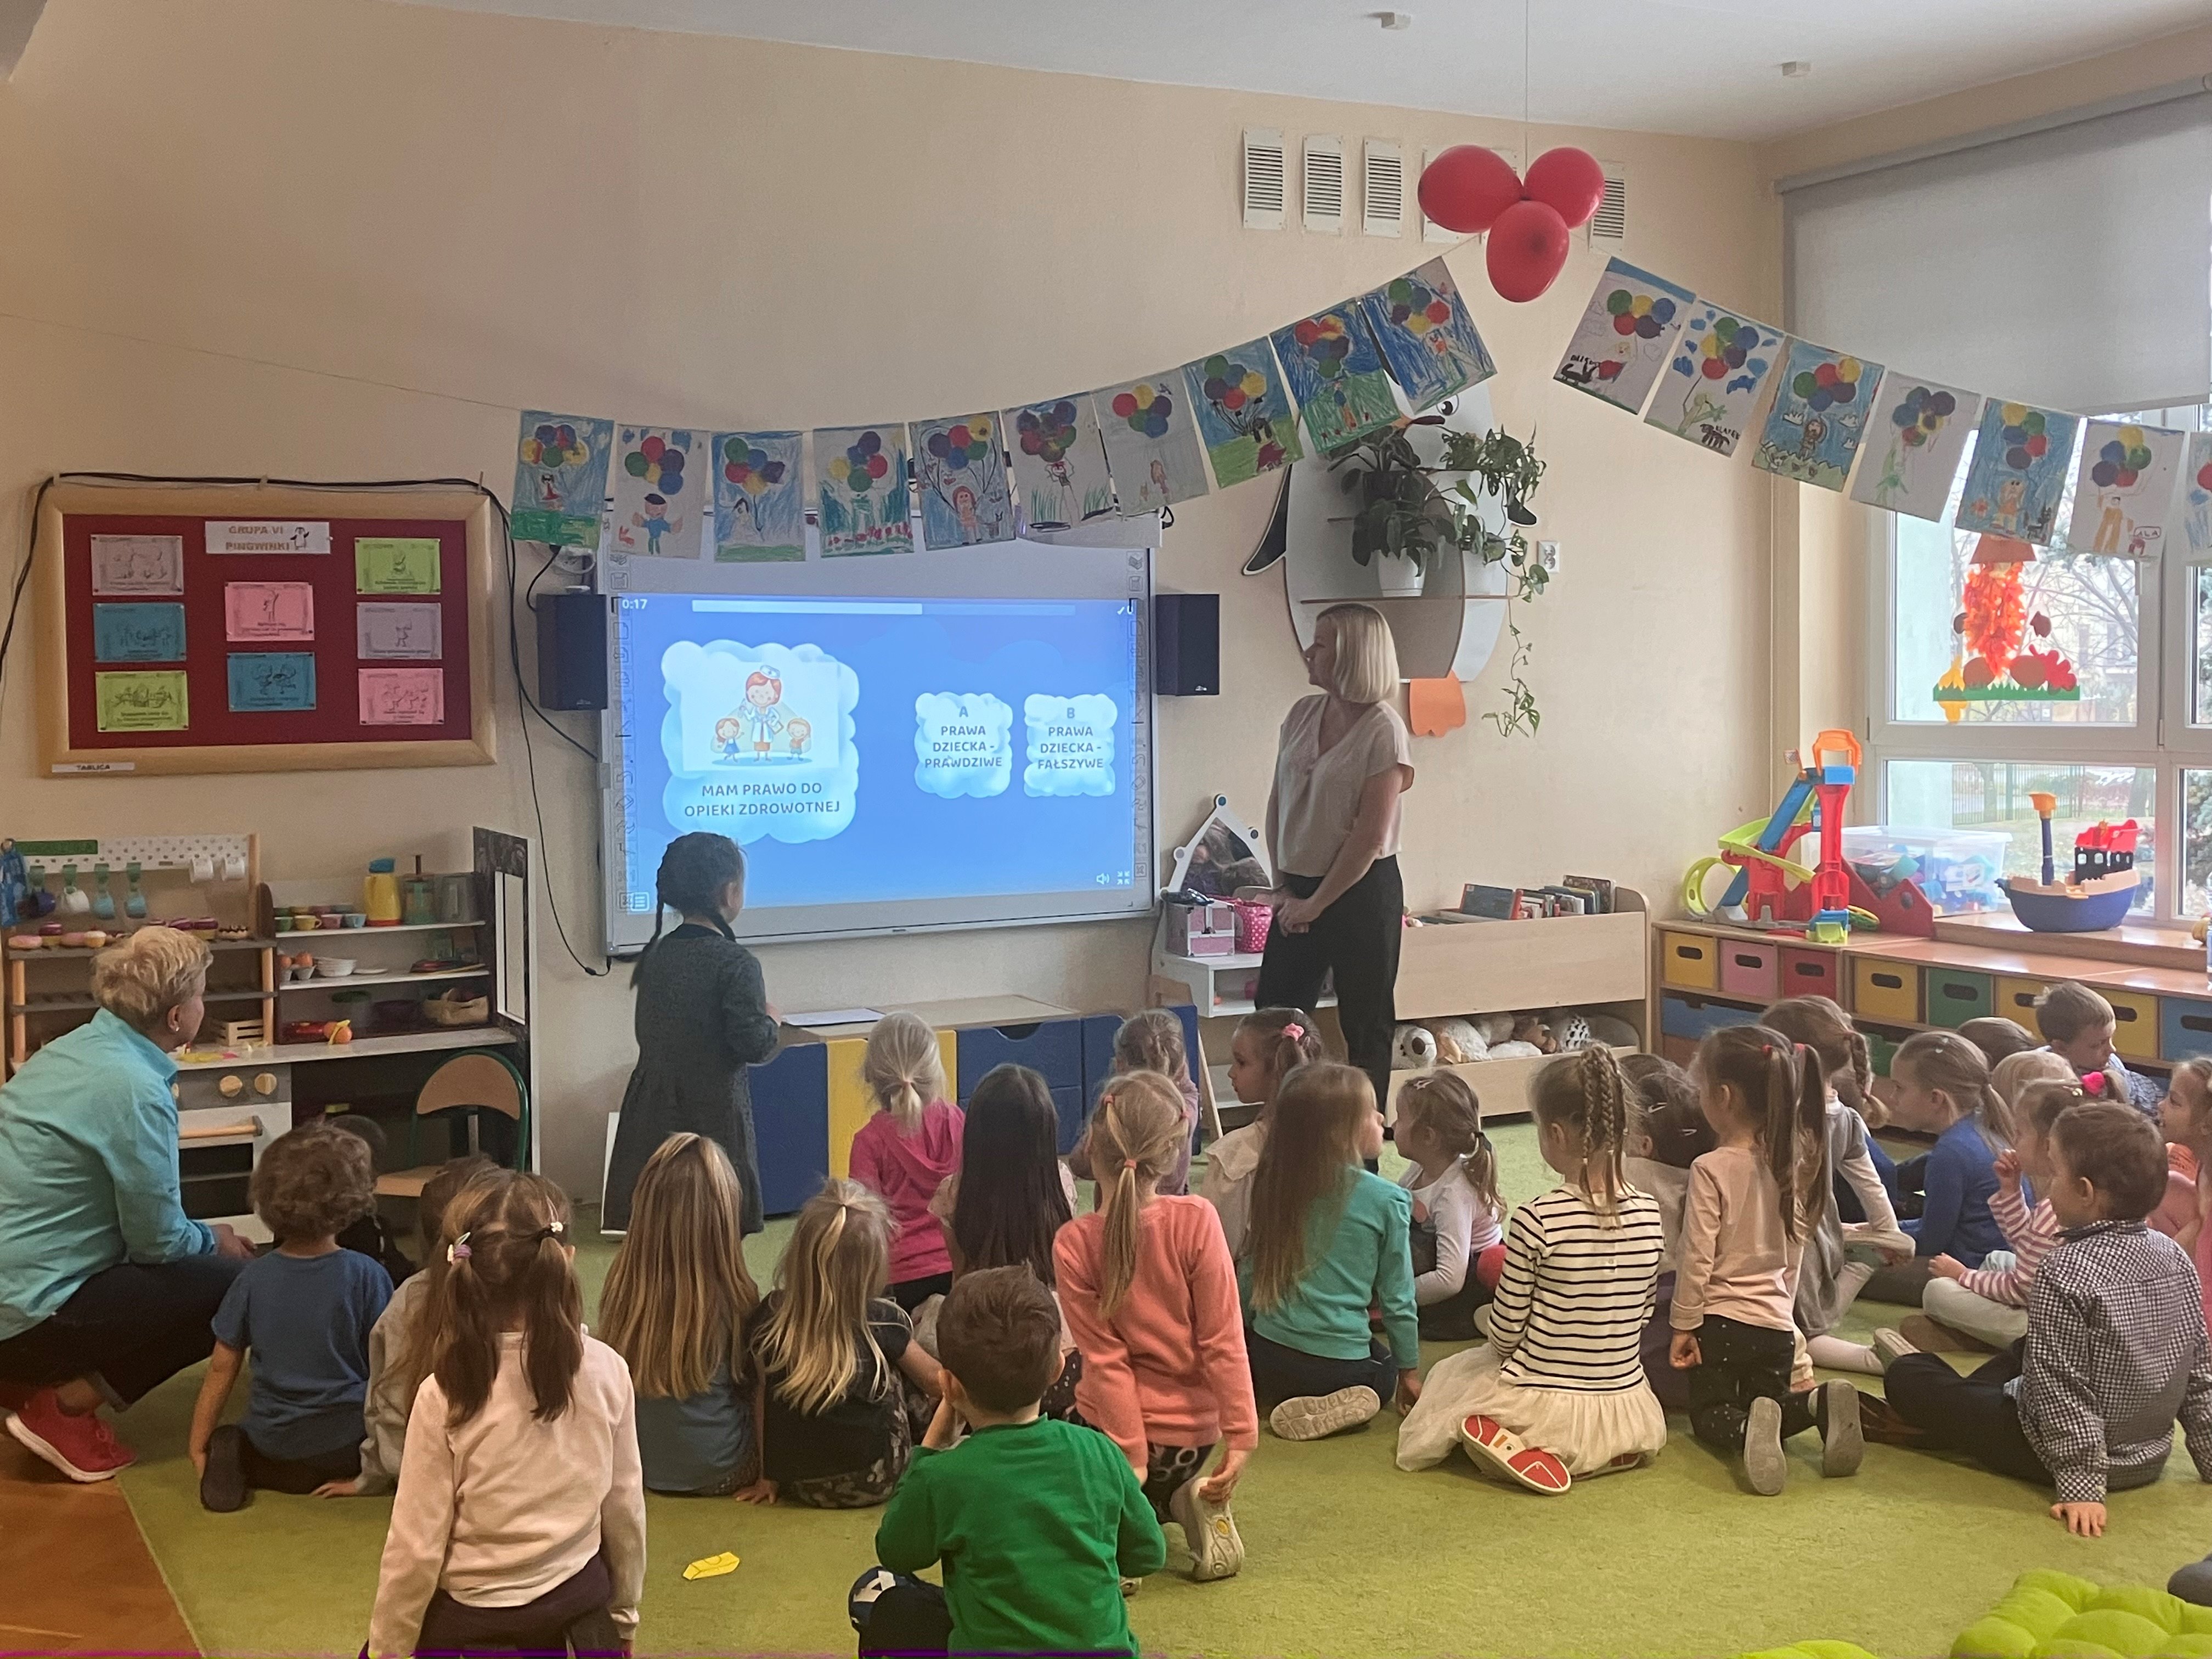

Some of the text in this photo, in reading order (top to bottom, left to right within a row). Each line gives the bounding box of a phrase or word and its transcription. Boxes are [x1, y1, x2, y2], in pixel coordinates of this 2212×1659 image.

[229, 526, 283, 534] GRUPA VI
[226, 541, 289, 550] PINGWINKI
[622, 599, 647, 609] 0:17
[959, 706, 968, 717] A
[1067, 708, 1075, 719] B
[941, 726, 986, 736] PRAWA
[1048, 726, 1093, 737] PRAWA
[933, 741, 986, 752] DZIECKA
[1041, 742, 1093, 753] DZIECKA
[925, 757, 1002, 768] PRAWDZIWE
[1038, 758, 1104, 769] FAŁSZYWE
[702, 783, 822, 796] MAM PRAWO DO
[685, 801, 839, 816] OPIEKI ZDROWOTNEJ
